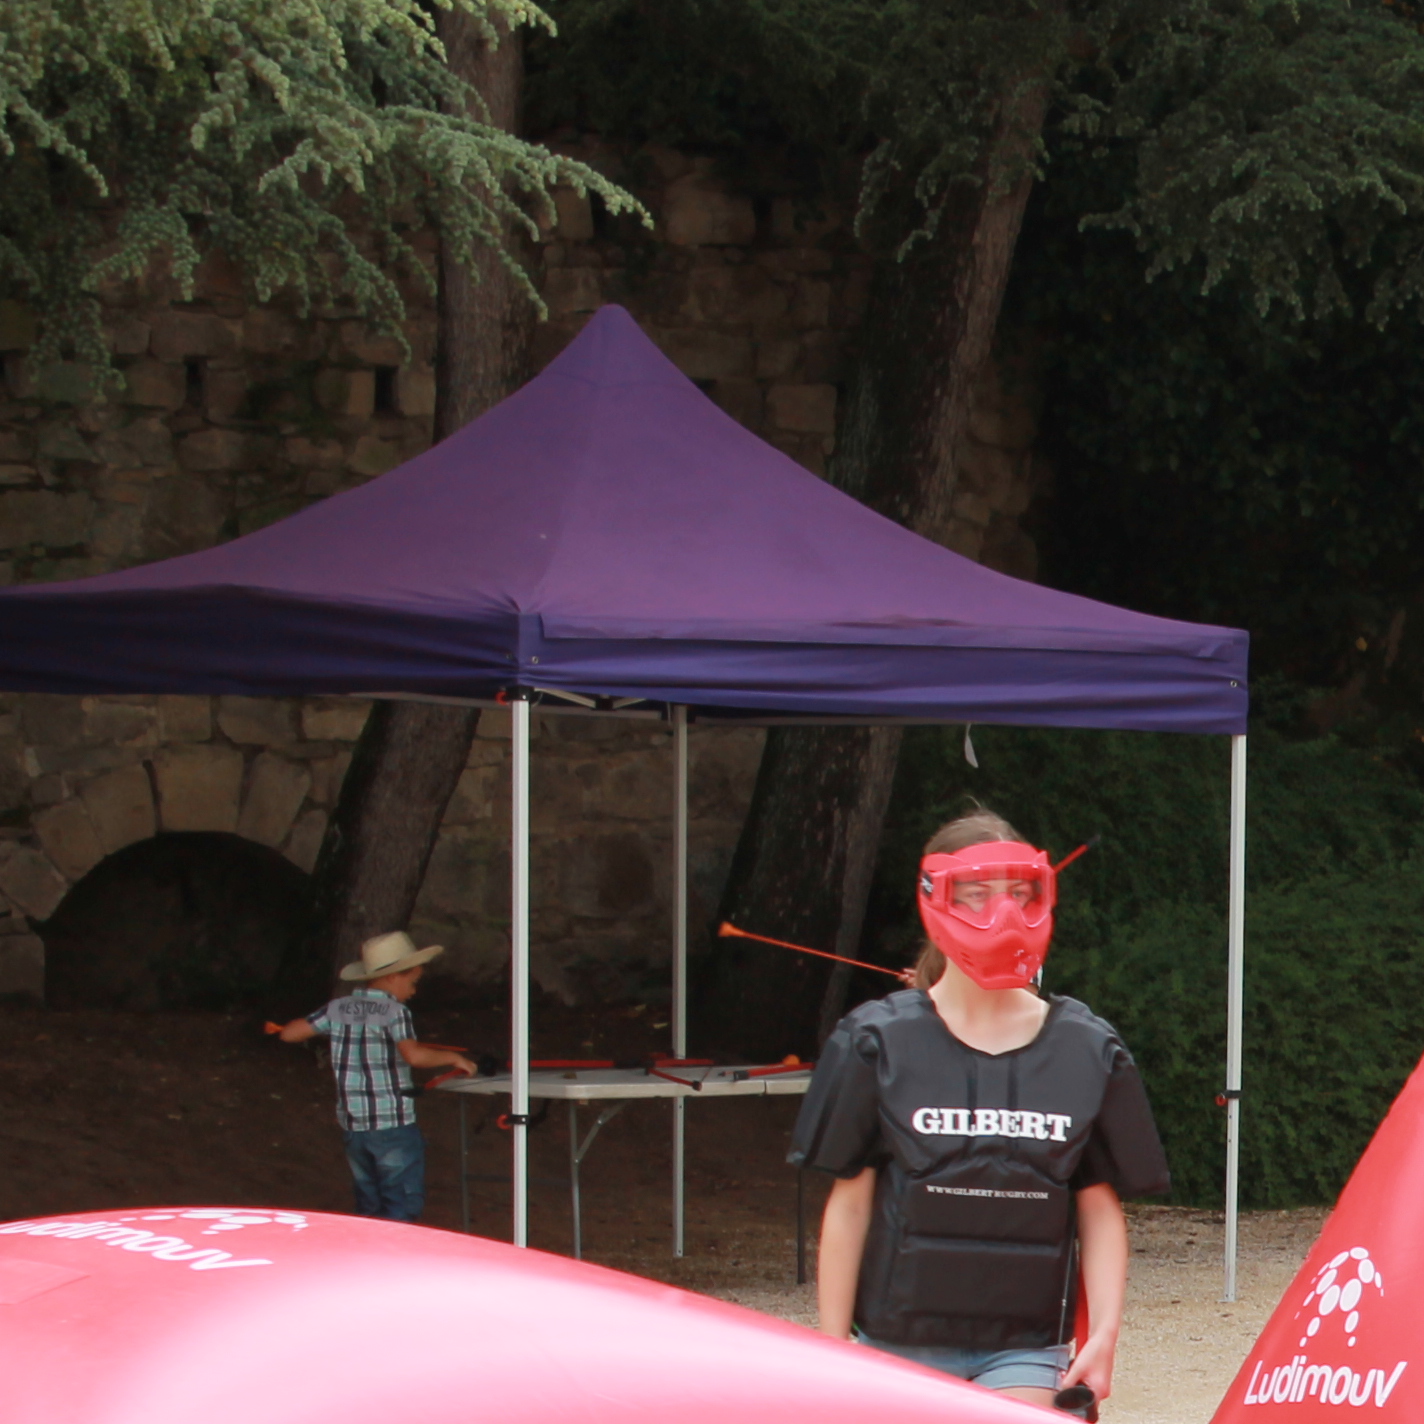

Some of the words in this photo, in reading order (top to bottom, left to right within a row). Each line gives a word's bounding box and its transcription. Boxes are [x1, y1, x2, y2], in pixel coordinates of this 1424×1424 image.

[912, 1107, 1072, 1142] GILBERT
[0, 1220, 274, 1271] udimouv
[1243, 1355, 1408, 1408] Ludimouv
